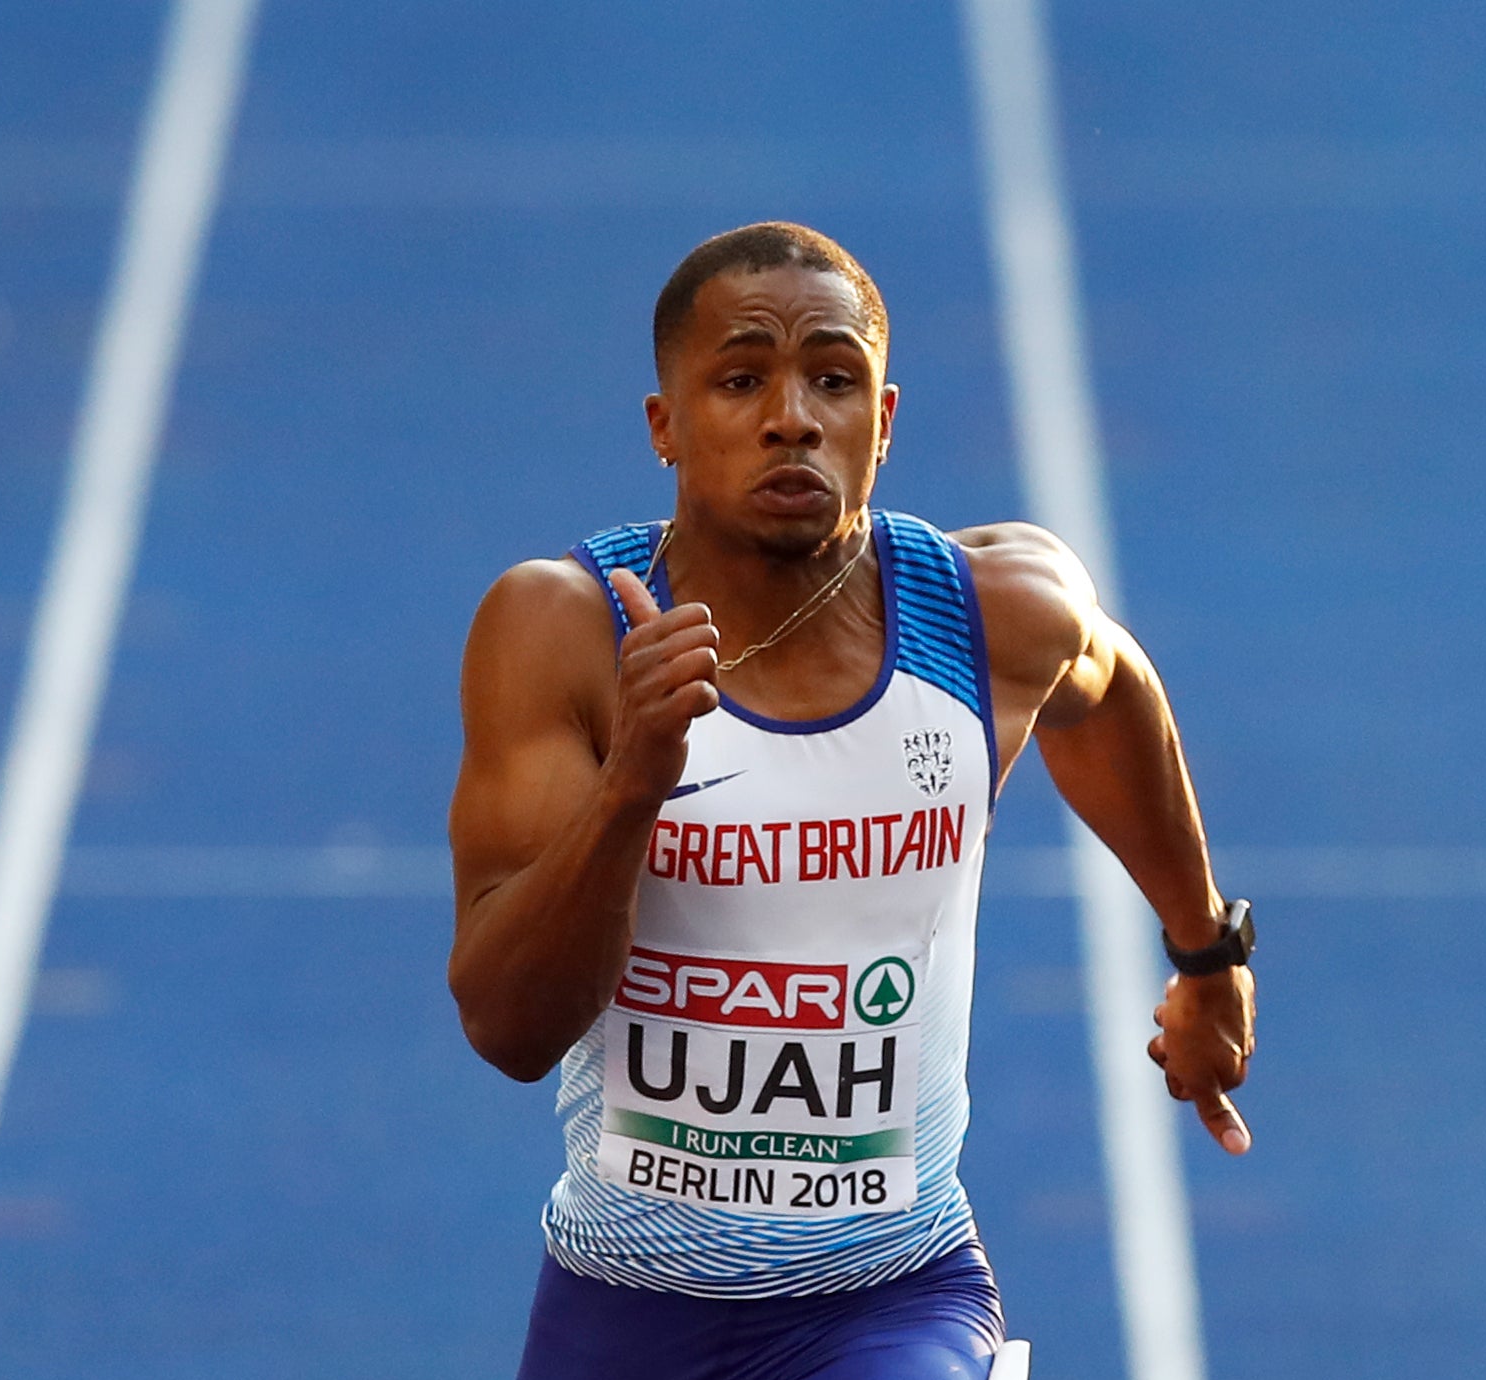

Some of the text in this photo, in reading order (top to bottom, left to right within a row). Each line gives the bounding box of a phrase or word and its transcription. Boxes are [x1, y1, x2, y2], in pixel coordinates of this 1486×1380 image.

[649, 804, 965, 886] GREAT BRITAIN
[621, 960, 841, 1020] SPAR
[627, 1024, 898, 1119] UJAH
[672, 1125, 680, 1145] I
[686, 1129, 742, 1156] RUN
[628, 1148, 887, 1209] BERLIN 2018
